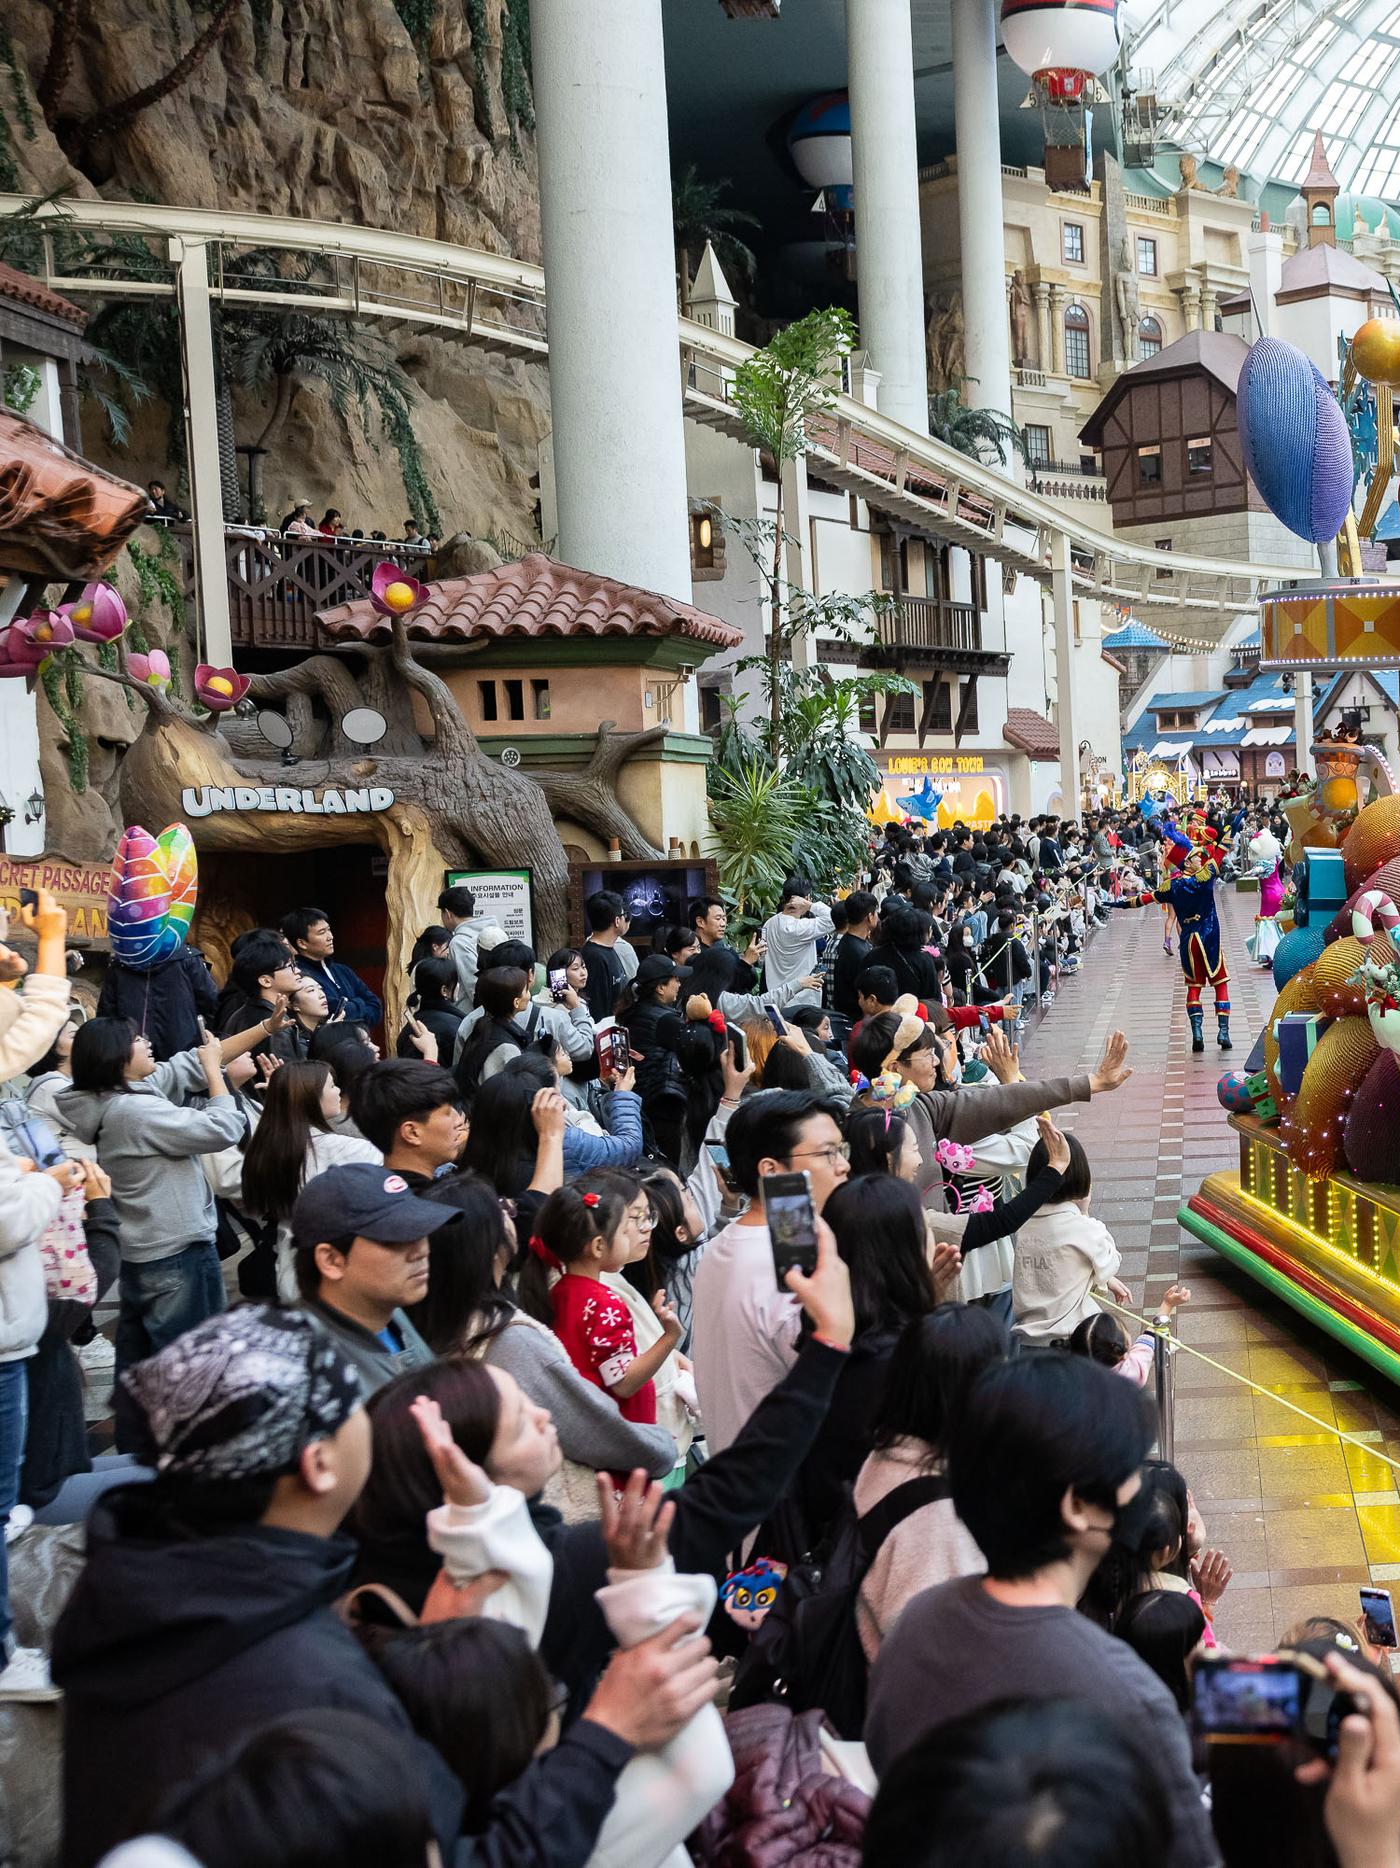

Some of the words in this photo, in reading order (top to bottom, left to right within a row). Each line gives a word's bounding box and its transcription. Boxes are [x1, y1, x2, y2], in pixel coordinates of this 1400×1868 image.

[1028, 92, 1037, 108] 5
[1095, 87, 1103, 102] 5
[182, 786, 396, 818] UNDERLAND
[43, 866, 111, 894] PASSAGE
[471, 884, 523, 892] INFORMATION
[1022, 1255, 1050, 1270] FILA
